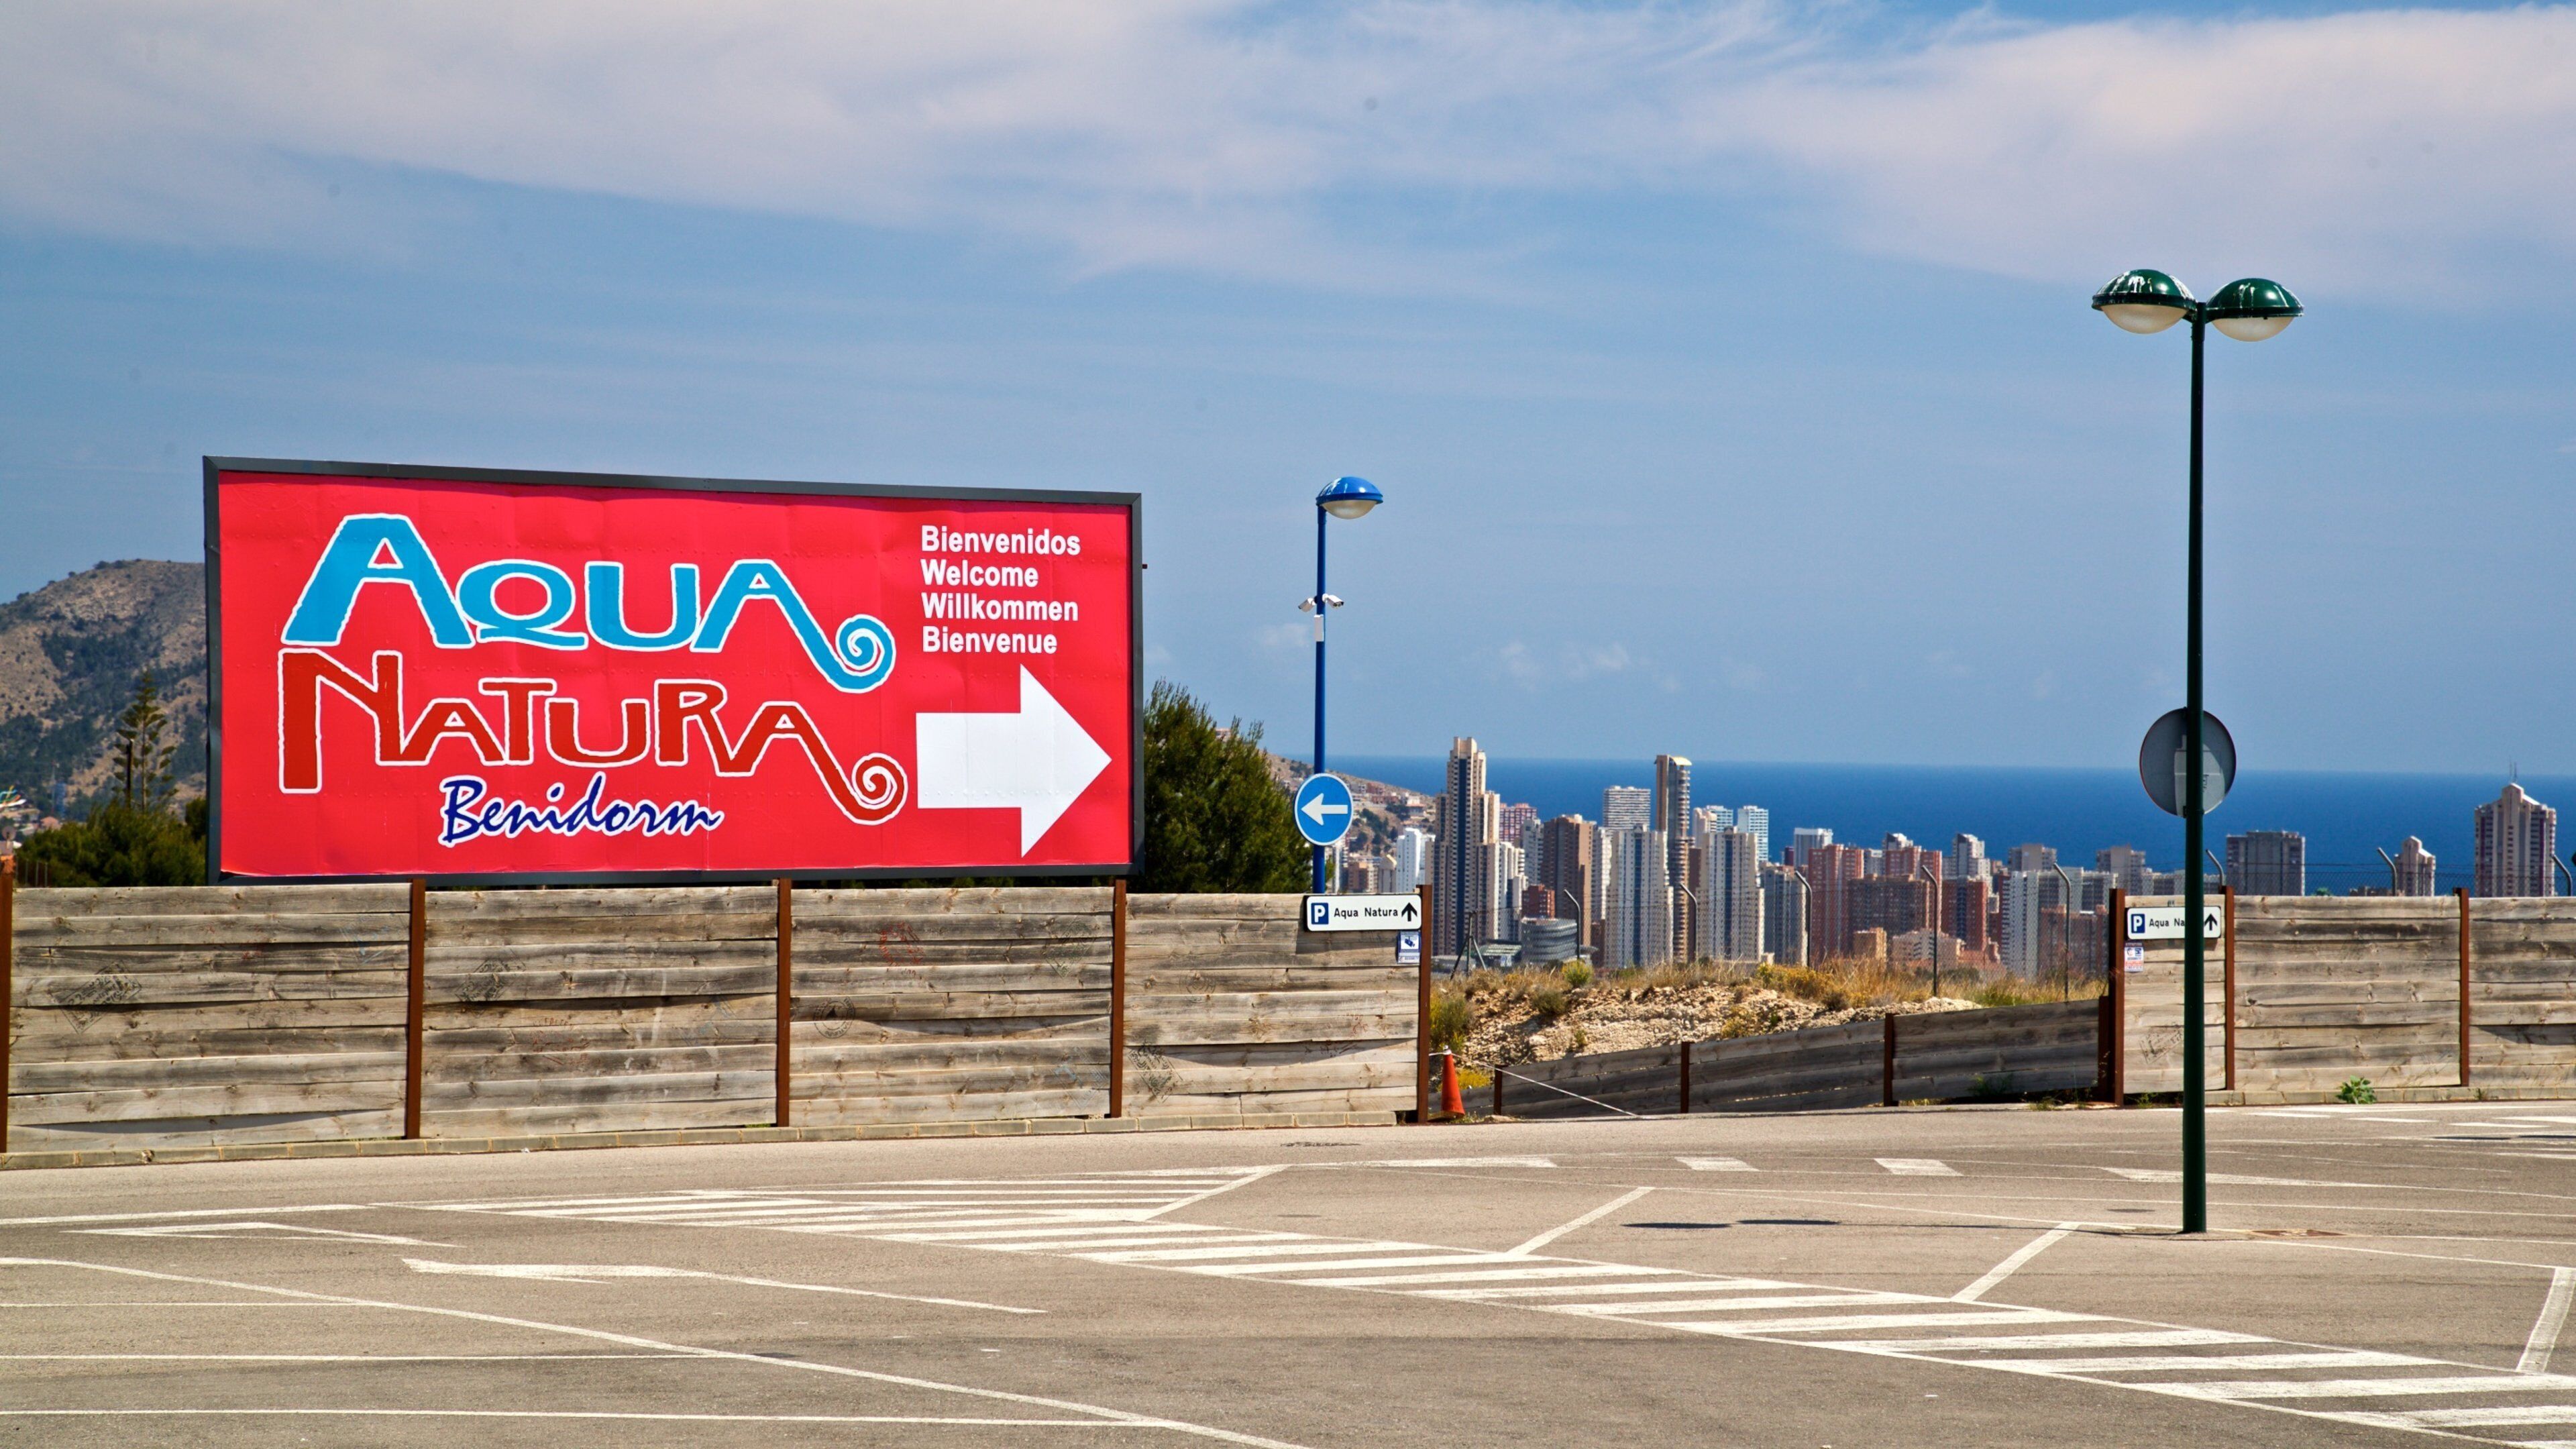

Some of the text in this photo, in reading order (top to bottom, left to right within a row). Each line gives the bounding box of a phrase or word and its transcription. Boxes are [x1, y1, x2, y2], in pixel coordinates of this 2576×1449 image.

[921, 525, 1081, 555] Bienvenidos
[920, 559, 1038, 588] Welcome
[280, 513, 897, 694] AQUA
[921, 592, 1079, 621] Willkommen
[922, 625, 1058, 654] Bienvenue
[277, 647, 908, 826] NATURA
[439, 773, 724, 847] Benidorm
[1313, 904, 1399, 923] P Aqua Natura
[2133, 915, 2143, 932] P
[2149, 918, 2169, 928] Aqua
